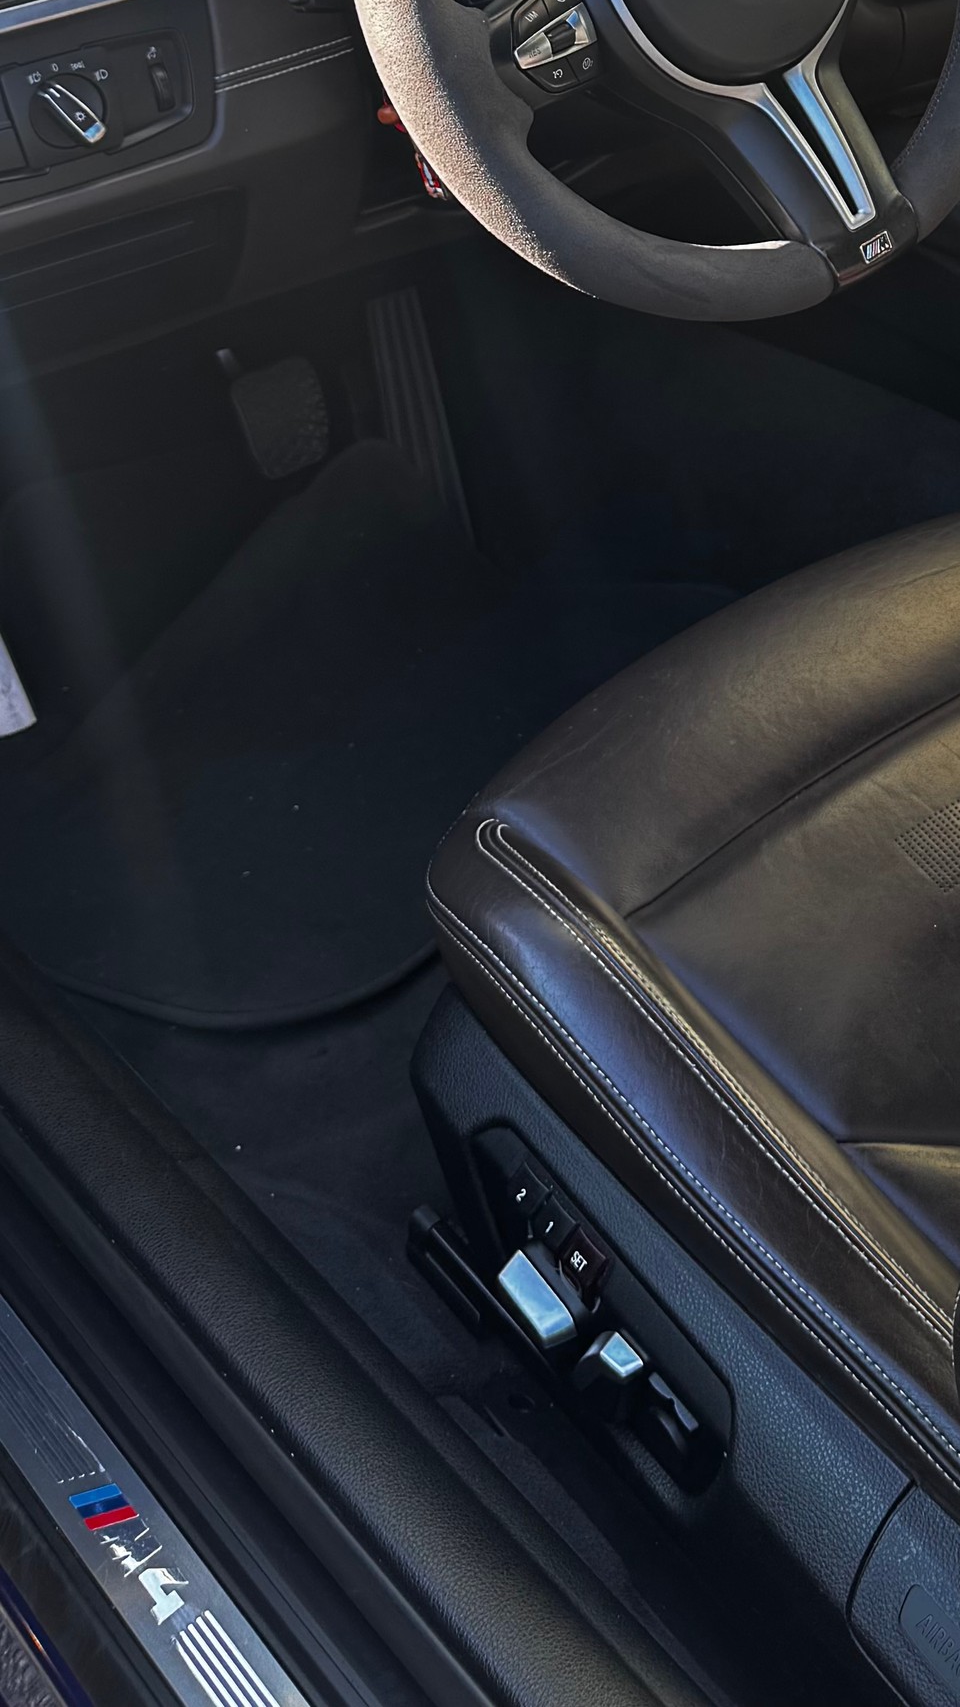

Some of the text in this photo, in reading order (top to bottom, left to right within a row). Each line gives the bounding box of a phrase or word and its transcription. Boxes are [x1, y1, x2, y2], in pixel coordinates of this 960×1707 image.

[524, 10, 539, 23] LIM
[528, 47, 542, 59] RES
[51, 63, 59, 72] 0
[516, 1188, 527, 1203] 2
[545, 1220, 554, 1234] 1
[570, 1250, 588, 1273] SET
